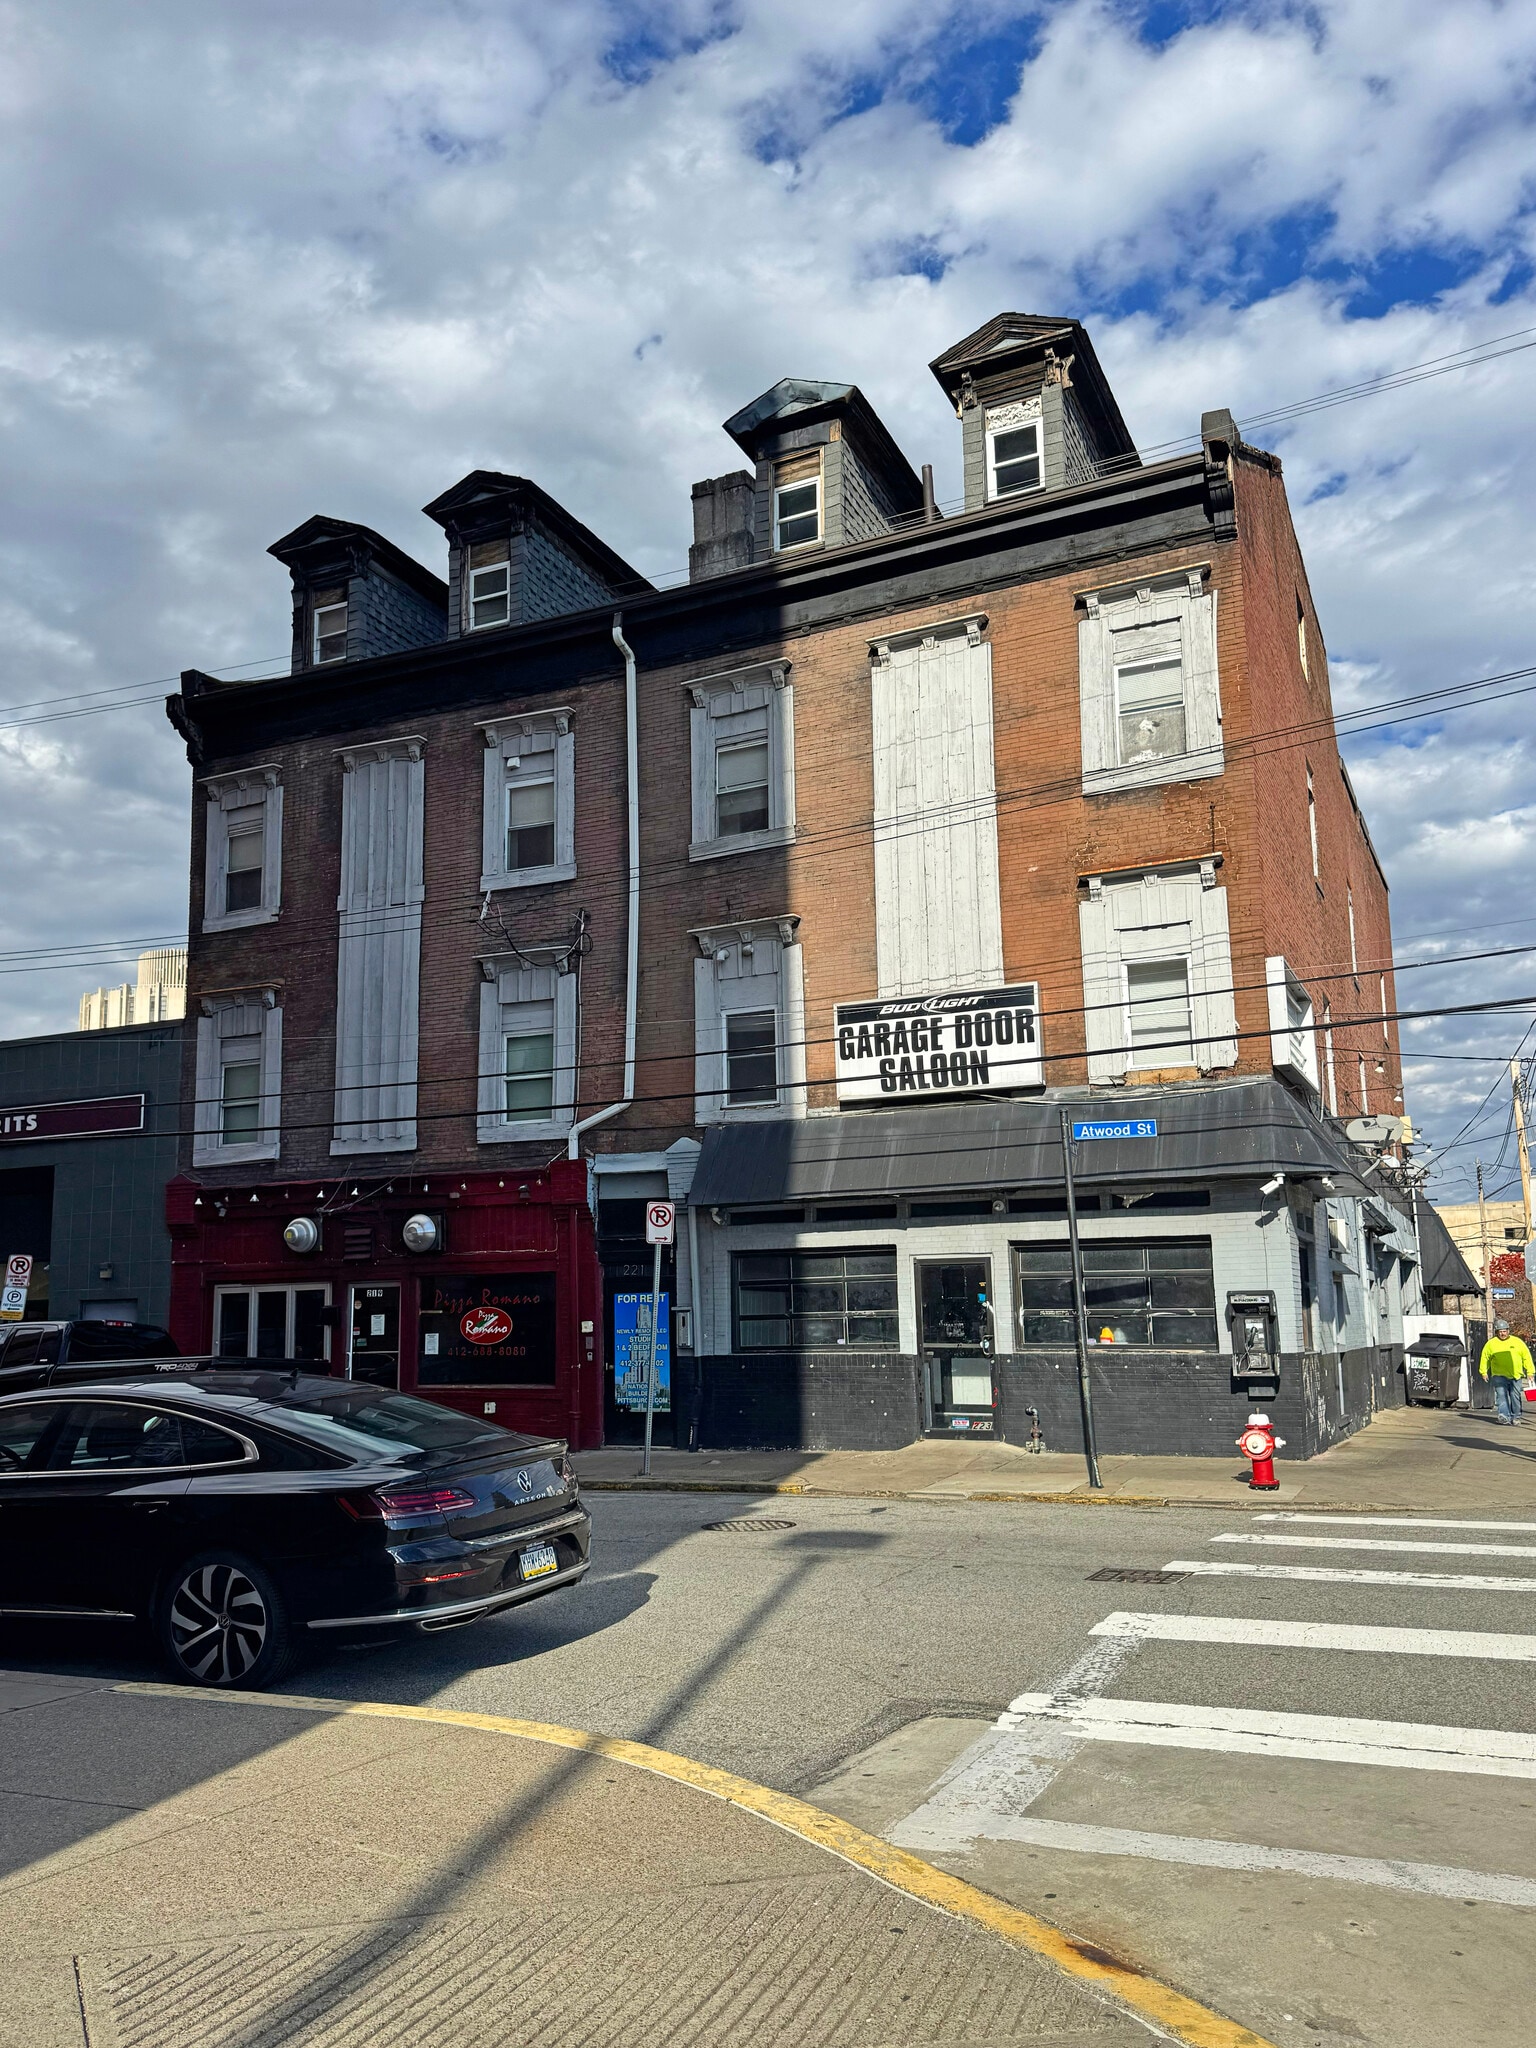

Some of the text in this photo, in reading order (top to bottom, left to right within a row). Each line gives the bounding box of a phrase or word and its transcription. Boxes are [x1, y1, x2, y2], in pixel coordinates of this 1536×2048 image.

[879, 995, 986, 1015] BUD LIGHT
[838, 1008, 1036, 1061] GARAGE DOOR
[879, 1050, 990, 1093] SALOON
[0, 1114, 38, 1133] ITS
[1080, 1122, 1152, 1138] Atwood St
[623, 1264, 644, 1276] 221
[434, 1288, 541, 1313] Pizza Romano
[617, 1293, 666, 1304] FOR RET
[478, 1310, 495, 1322] Pizza
[465, 1320, 508, 1335] Romano
[447, 1346, 526, 1357] 412-688-8080
[973, 1422, 992, 1430] 223
[514, 1492, 546, 1506] ARTEON
